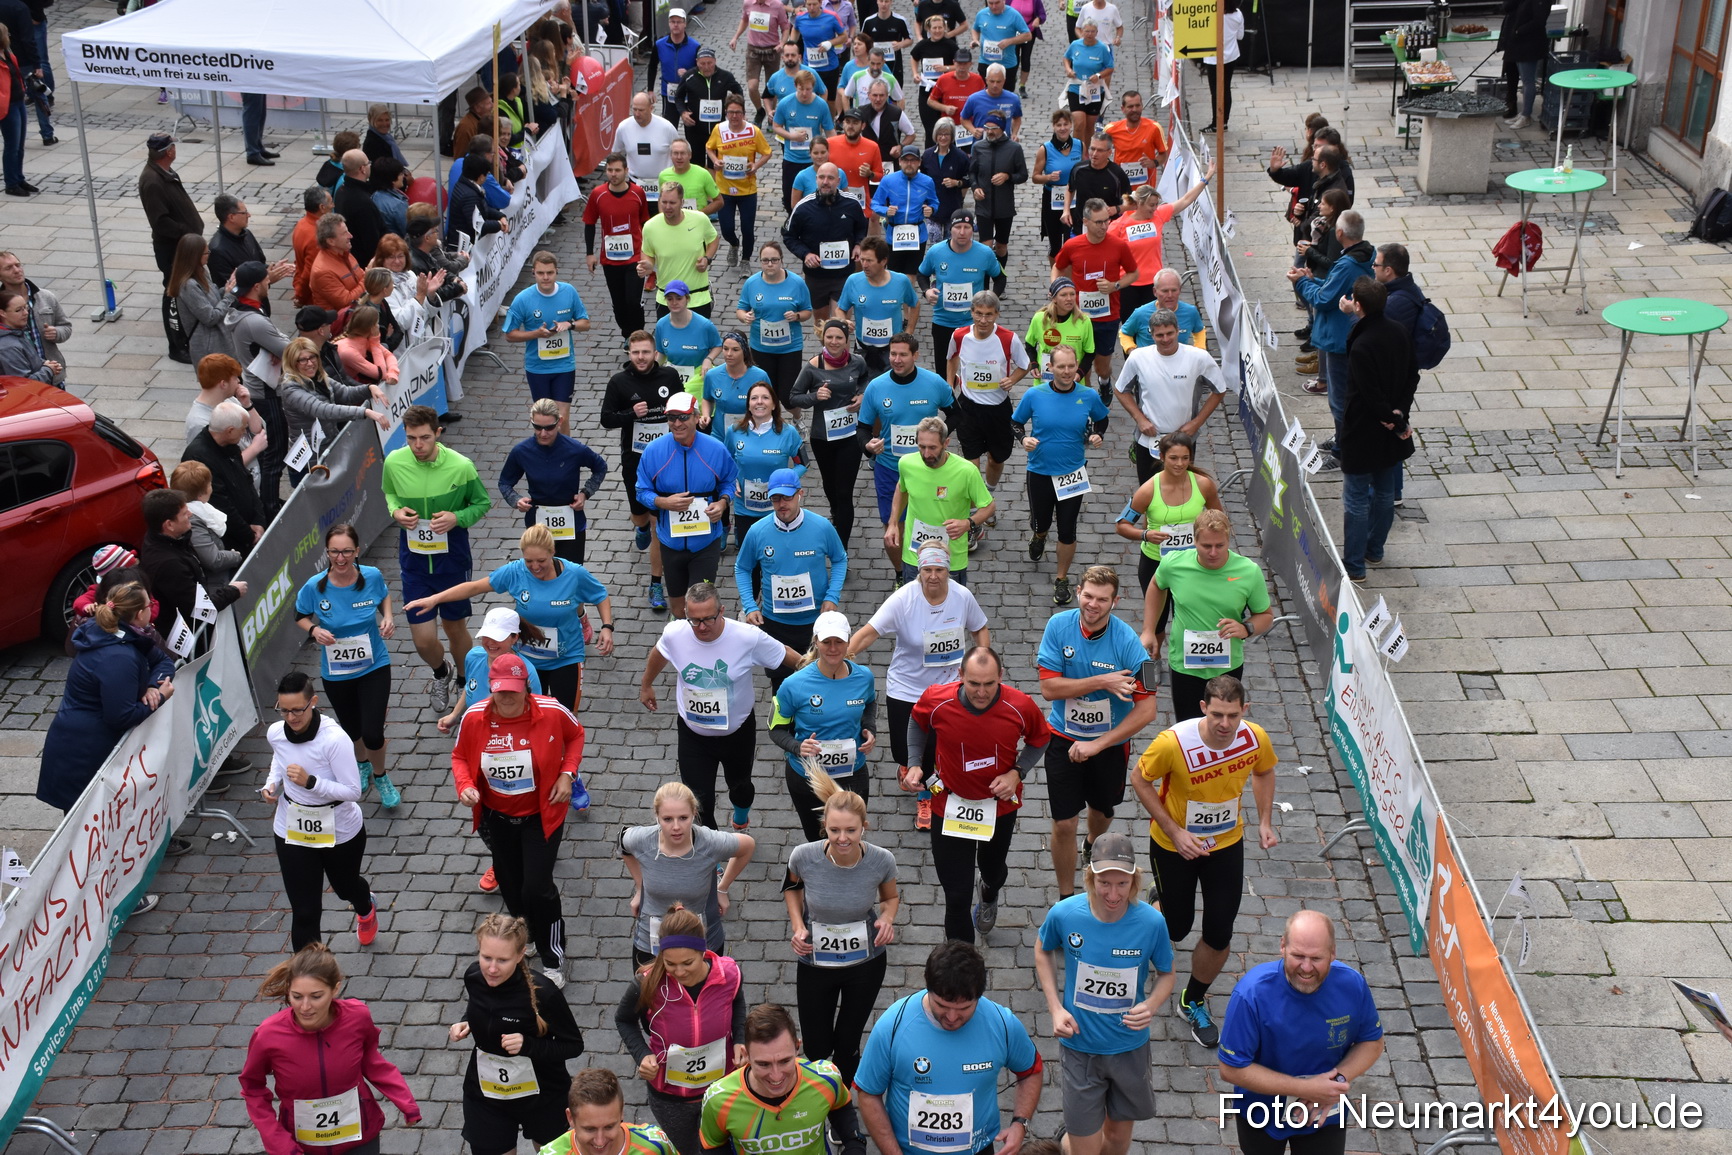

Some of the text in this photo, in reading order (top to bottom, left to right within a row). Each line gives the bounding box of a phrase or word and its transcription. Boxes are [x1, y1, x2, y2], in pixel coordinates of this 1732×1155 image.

[1175, 3, 1217, 16] Jugend
[1188, 16, 1210, 29] lauf
[82, 44, 275, 70] BMW ConnectedDrive
[84, 62, 232, 82] Vernetzt, um frei zu sein.
[722, 143, 738, 151] MAX
[726, 163, 743, 171] 2623
[1125, 168, 1143, 177] 2574
[1130, 223, 1152, 234] 2423
[896, 233, 916, 241] 2219
[609, 242, 629, 251] 2410
[824, 249, 845, 259] 2187
[947, 291, 968, 301] 2374
[1084, 299, 1105, 308] 2060
[764, 328, 785, 337] 2111
[866, 327, 888, 338] 2935
[546, 339, 563, 349] 250
[973, 372, 992, 382] 259
[831, 414, 854, 429] 2736
[291, 447, 306, 465] swn
[1058, 471, 1083, 486] 2324
[750, 490, 768, 501] 290
[545, 517, 566, 527] 188
[678, 510, 700, 522] 224
[418, 530, 433, 541] 83
[1166, 533, 1194, 546] 2576
[777, 586, 806, 599] 2125
[242, 562, 292, 655] BOCK
[352, 600, 374, 608] BOCK
[174, 630, 188, 651] swn
[930, 639, 960, 654] 2053
[1388, 635, 1404, 654] swn
[333, 647, 366, 660] 2476
[1190, 642, 1223, 655] 2264
[1092, 661, 1115, 670] BOCK
[688, 700, 721, 713] 2054
[846, 698, 865, 706] BOCK
[1071, 709, 1104, 723] 2480
[815, 752, 849, 765] 2265
[488, 765, 525, 780] 2557
[1190, 753, 1260, 786] MAX BÖGL
[956, 806, 984, 822] 206
[1194, 809, 1231, 825] 2612
[296, 818, 323, 833] 108
[958, 823, 979, 832] Rüdiger
[820, 936, 860, 952] 2416
[1112, 948, 1141, 956] BOCK
[1084, 978, 1127, 997] 2763
[33, 991, 88, 1078] Service-Line:
[686, 1056, 707, 1074] 25
[962, 1061, 993, 1073] BOCK
[499, 1068, 510, 1083] 8
[316, 1110, 340, 1129] 24
[917, 1110, 963, 1130] 2283
[315, 1130, 341, 1139] Belinda
[741, 1122, 823, 1155] BOCK
[925, 1134, 955, 1143] Christian
